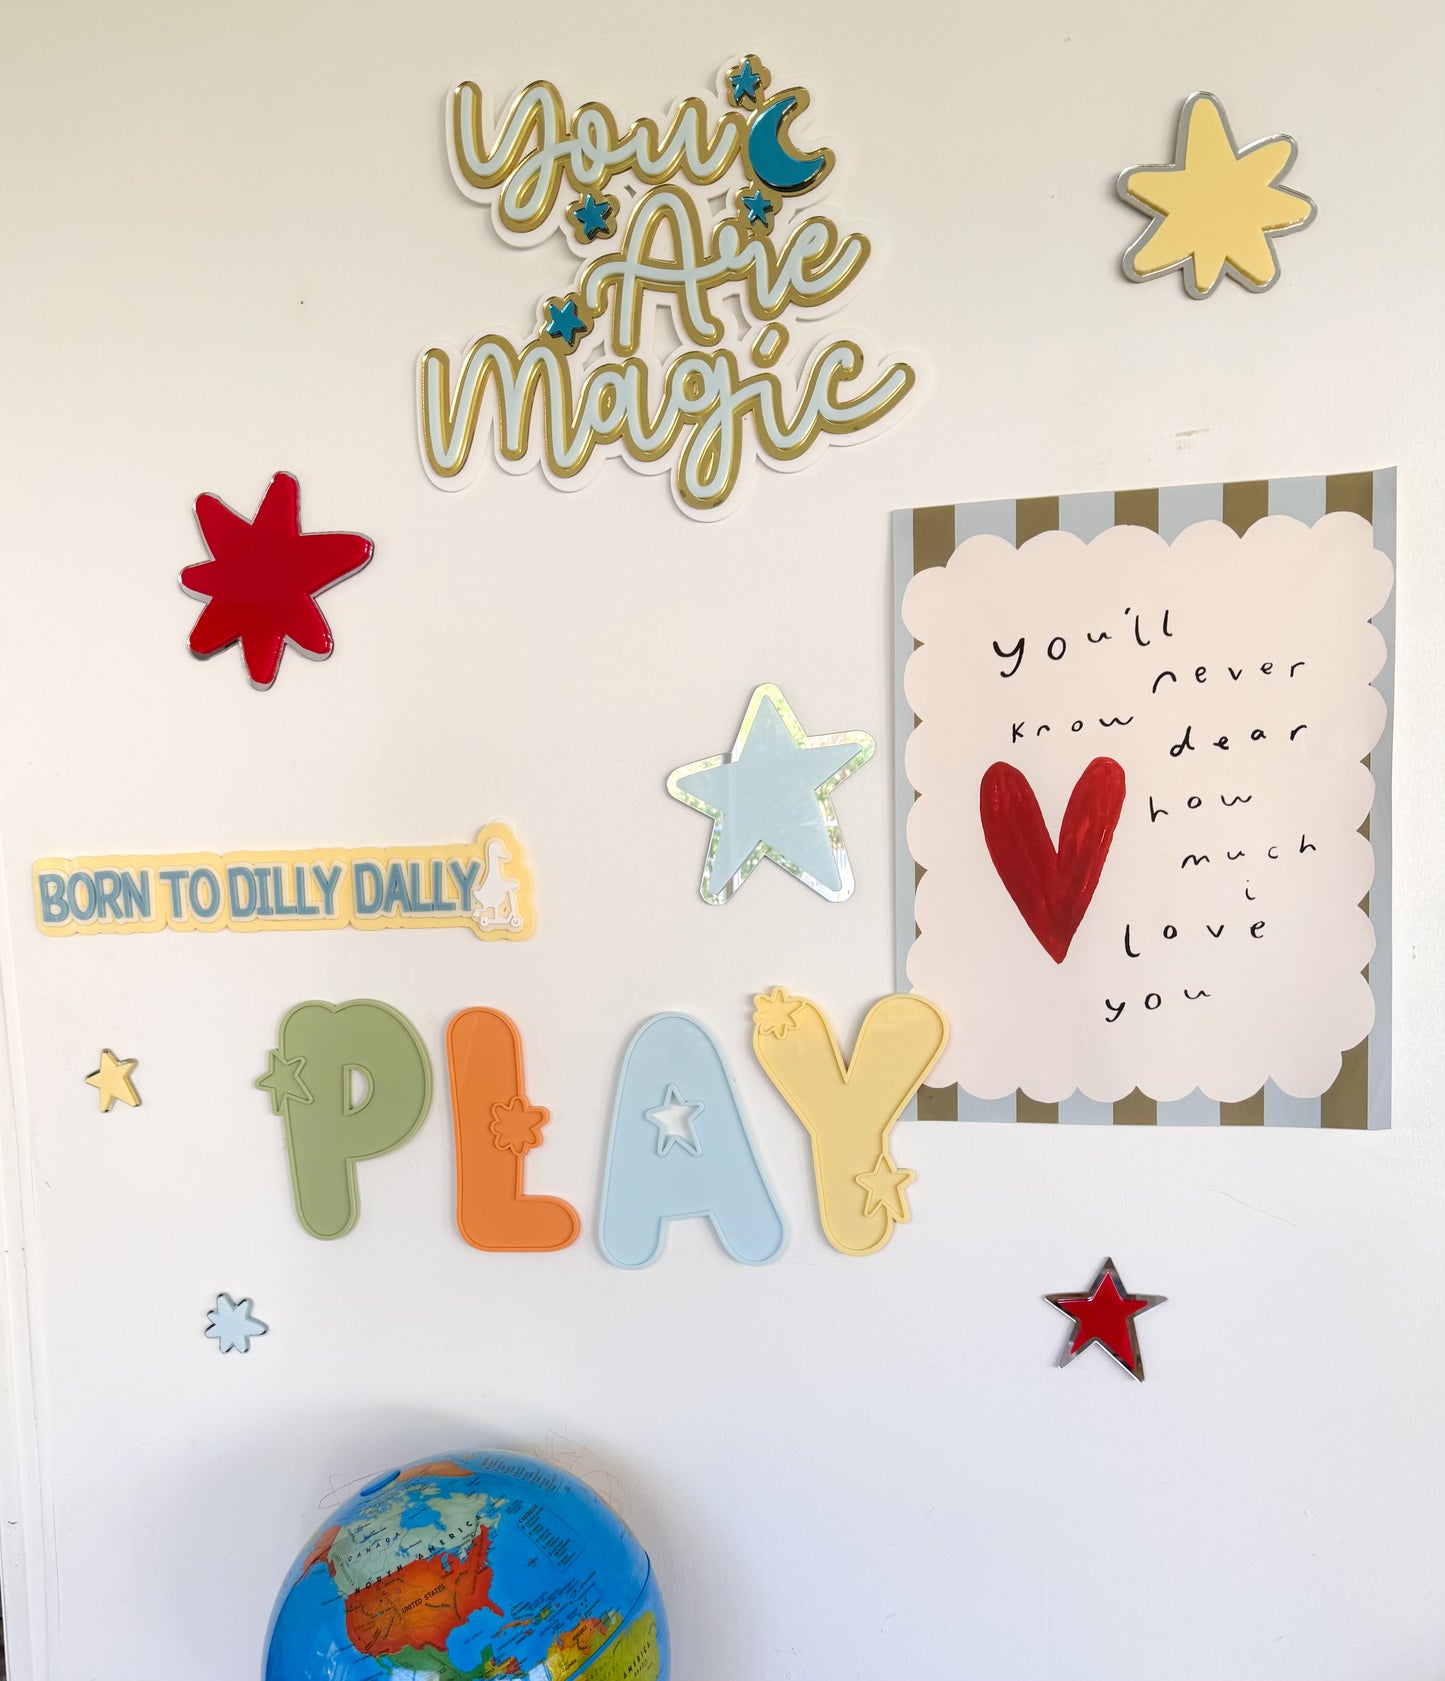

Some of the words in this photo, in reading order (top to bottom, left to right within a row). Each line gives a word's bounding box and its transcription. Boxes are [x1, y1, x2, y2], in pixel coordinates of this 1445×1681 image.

[579, 183, 871, 356] Are
[992, 607, 1173, 678] you'll
[1152, 661, 1306, 694] never
[1012, 716, 1134, 744] know
[1169, 725, 1308, 758] dear
[1149, 795, 1252, 823] how
[1181, 834, 1317, 869] much
[39, 869, 153, 922] BORN
[159, 867, 220, 918] TO
[227, 863, 348, 915] DILLY
[353, 862, 481, 914] DALLY
[1245, 880, 1256, 901] i
[1124, 920, 1266, 958] love
[1105, 989, 1212, 1023] you
[255, 986, 950, 1269] PLAY
[347, 1532, 401, 1562] CANADA
[418, 1514, 482, 1559] AMERICA
[401, 1599, 423, 1614] UNITED
[424, 1584, 446, 1601] STATES
[622, 1641, 651, 1679] AMERICA
